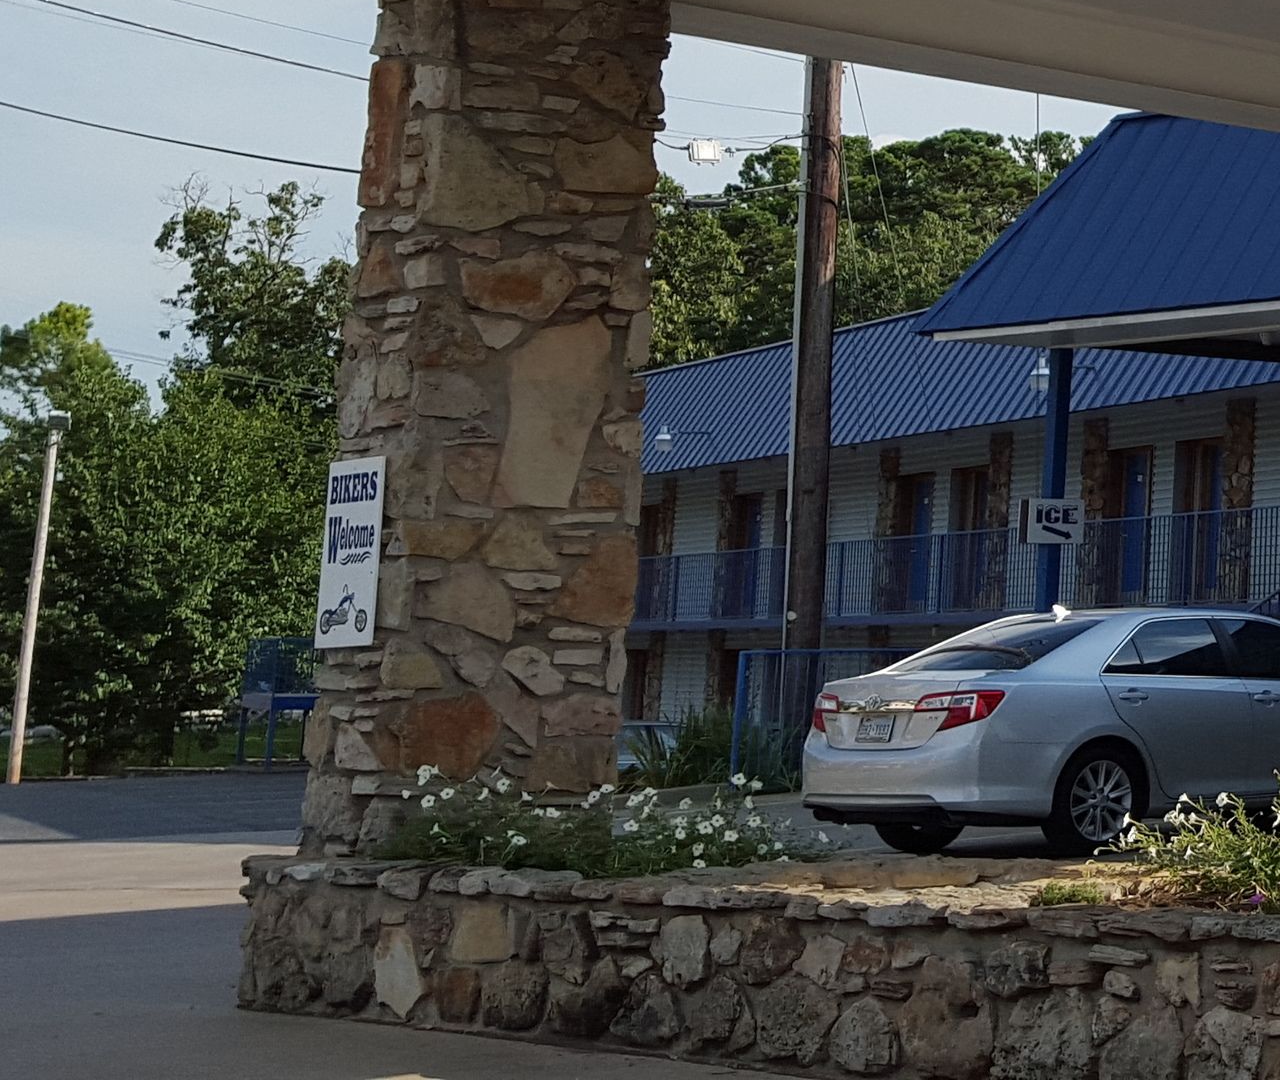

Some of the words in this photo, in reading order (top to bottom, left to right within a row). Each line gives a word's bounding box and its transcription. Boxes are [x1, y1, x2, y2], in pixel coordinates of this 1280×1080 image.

[330, 471, 378, 504] BIKERS
[1036, 504, 1078, 524] ICE
[327, 517, 375, 564] Welcome
